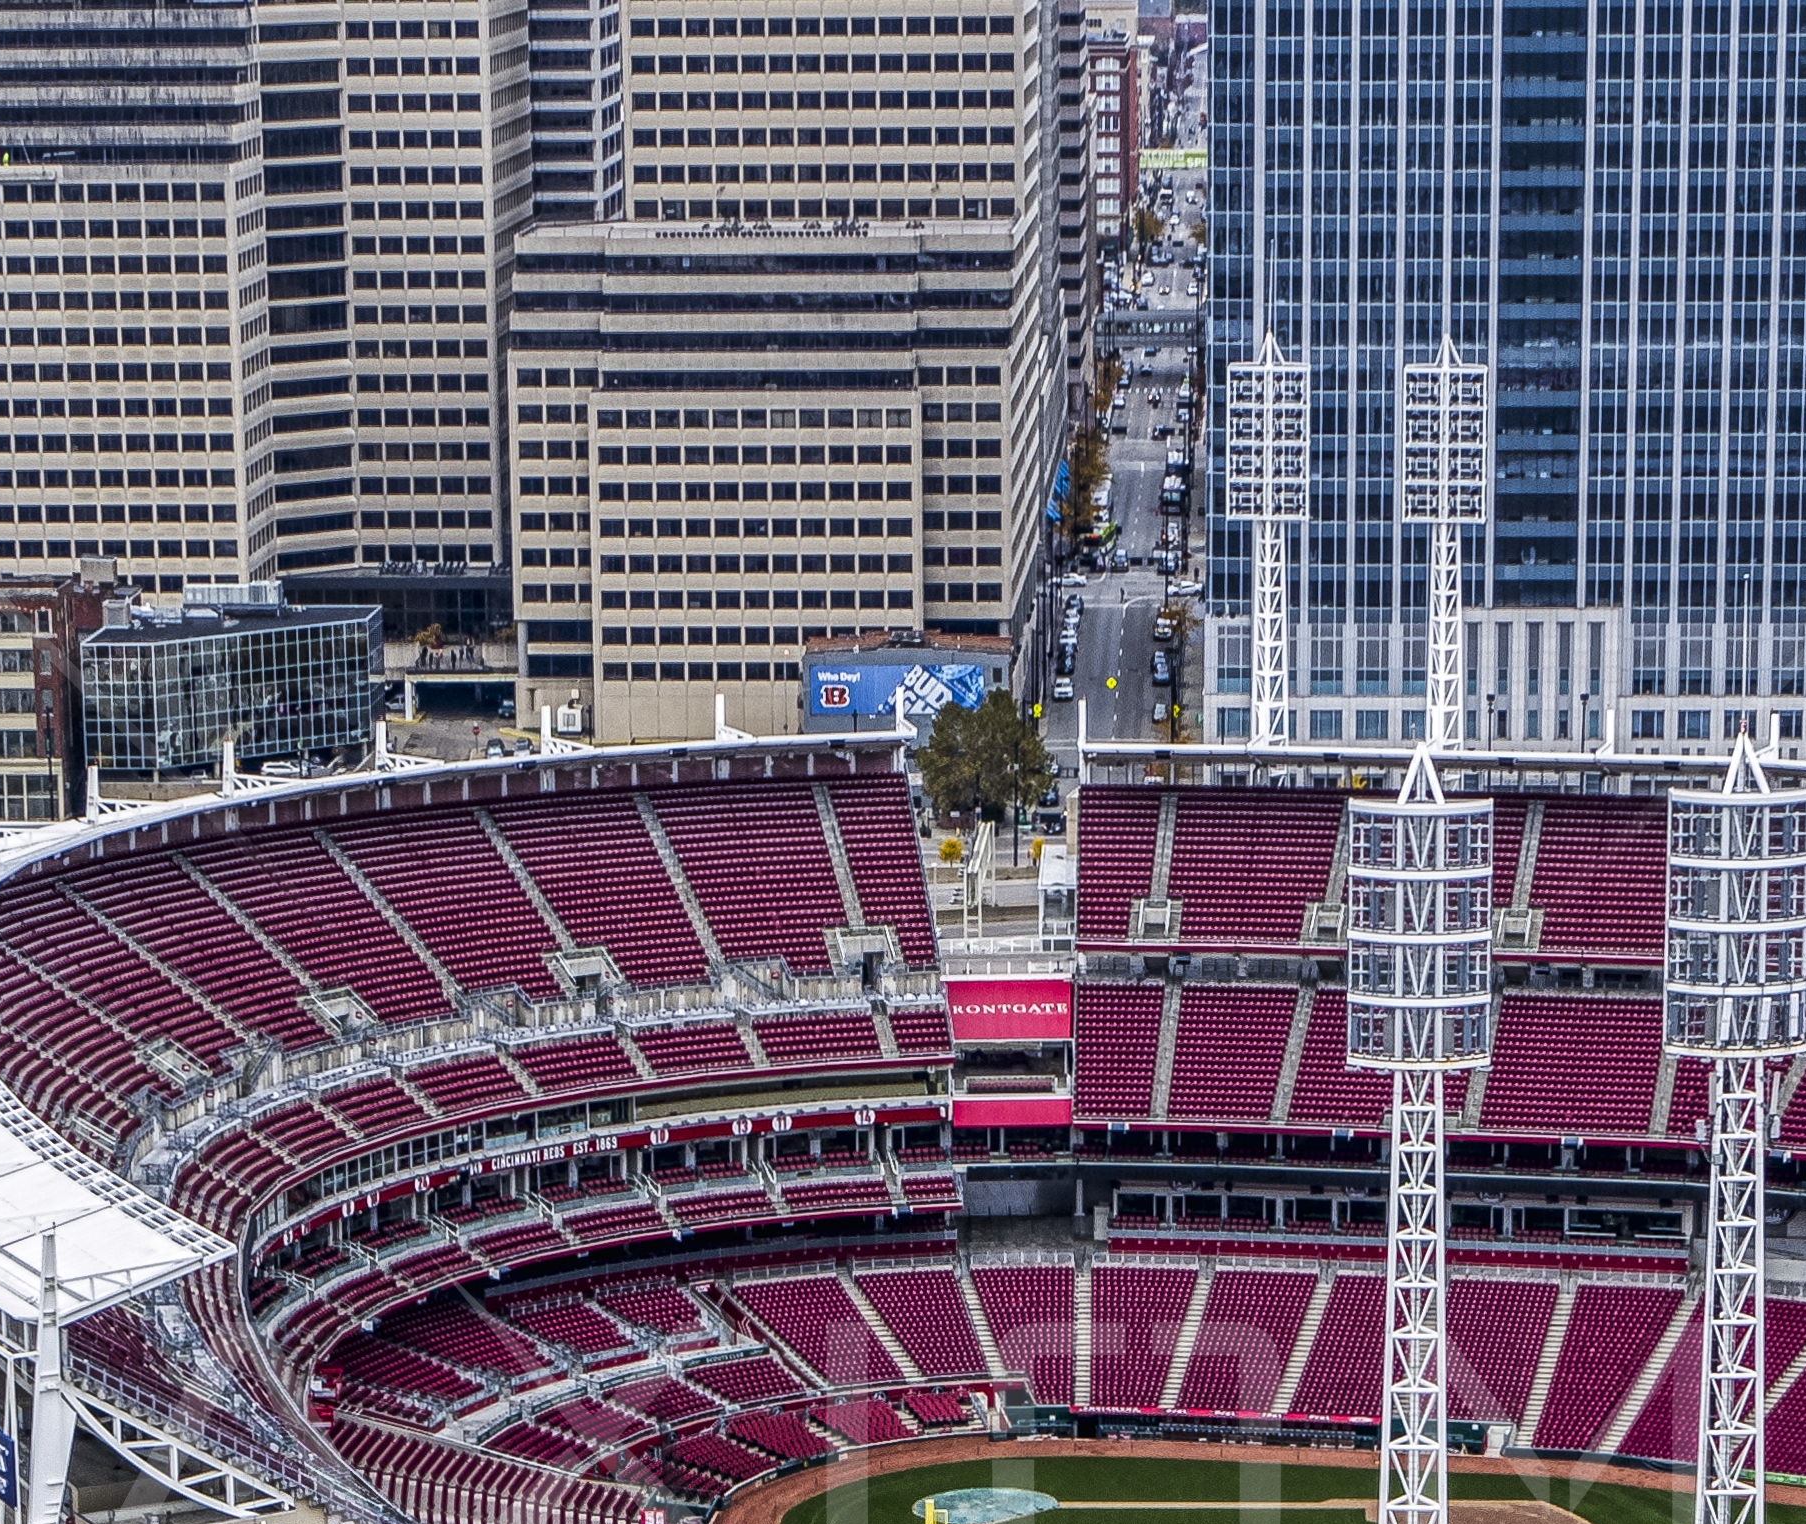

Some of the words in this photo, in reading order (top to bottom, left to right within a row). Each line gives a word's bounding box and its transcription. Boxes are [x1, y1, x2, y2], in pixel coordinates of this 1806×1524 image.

[818, 672, 838, 681] Who
[840, 672, 860, 682] Dey!
[904, 664, 953, 708] BUD
[491, 1149, 541, 1171] CINCINNATI
[543, 1145, 565, 1162] REDS
[573, 1140, 593, 1157] EST.
[596, 1136, 618, 1151] 1869
